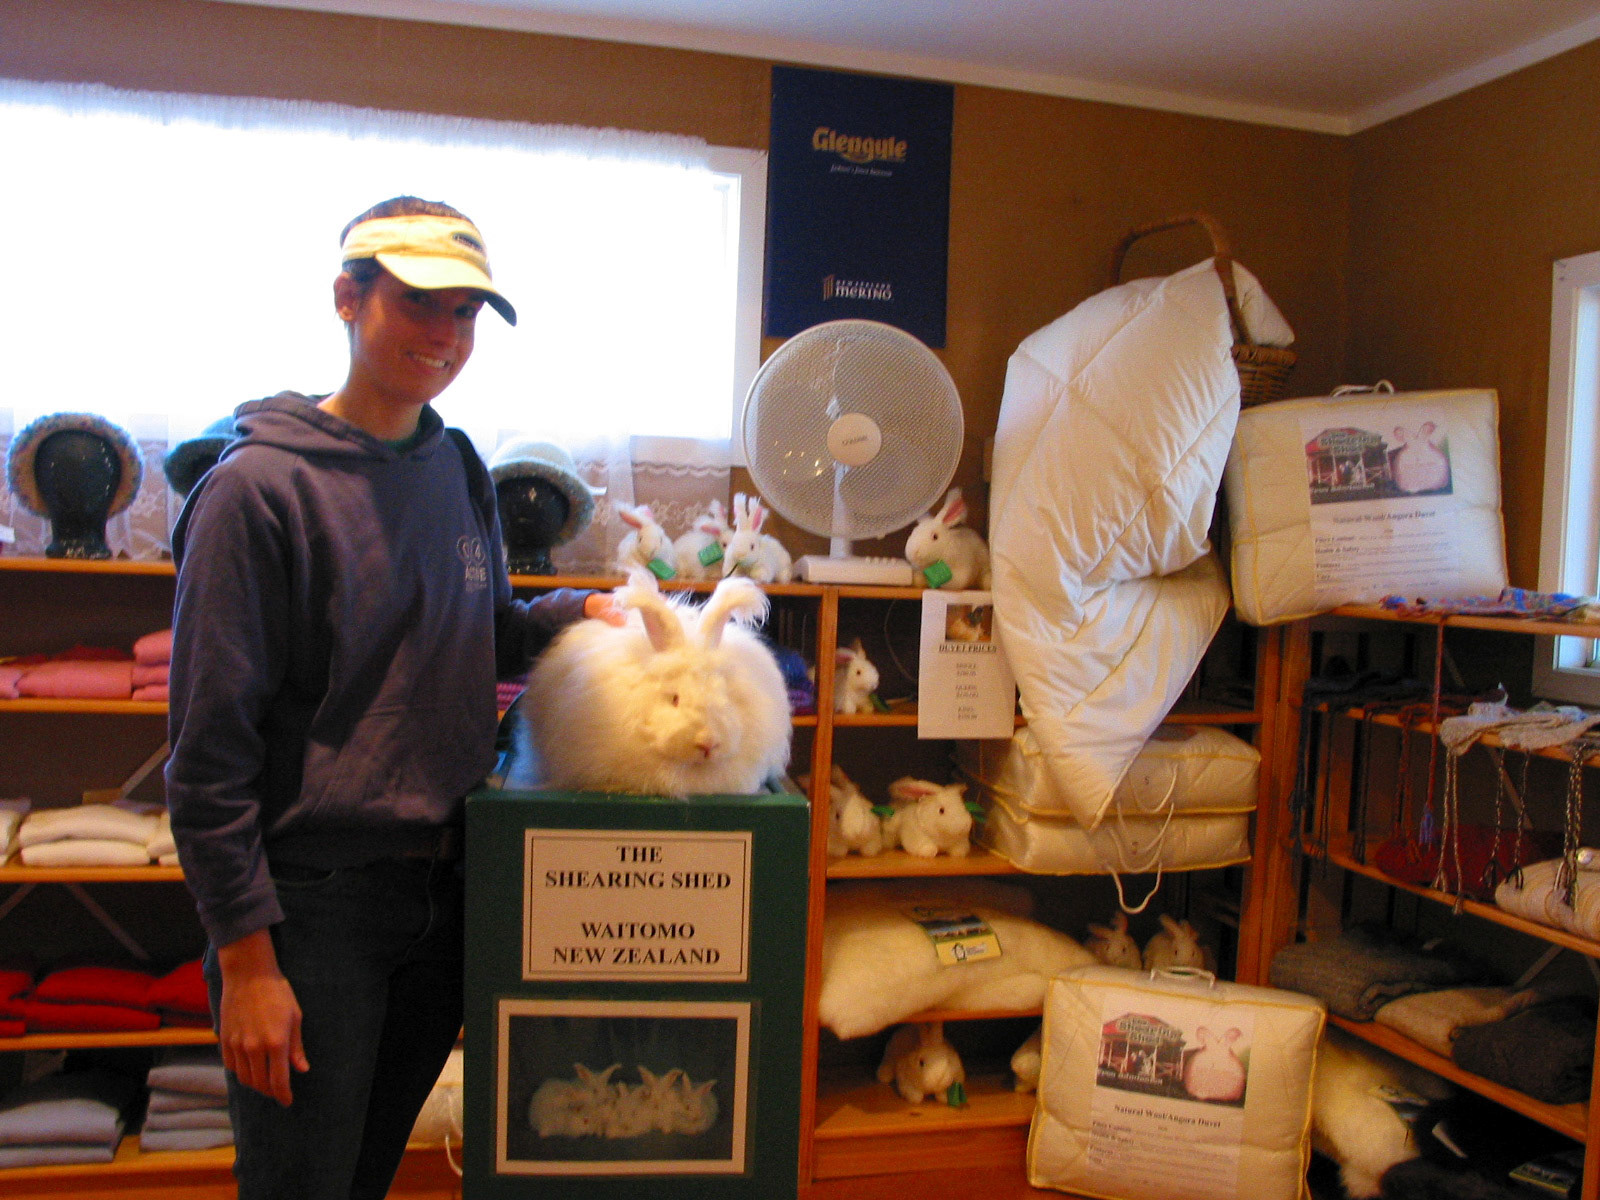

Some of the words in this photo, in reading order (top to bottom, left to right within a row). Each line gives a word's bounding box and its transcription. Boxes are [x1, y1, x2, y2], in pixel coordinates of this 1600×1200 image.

[812, 126, 908, 161] Glengyle
[616, 845, 663, 863] THE
[545, 870, 665, 889] SHEARING
[671, 871, 732, 890] SHED
[581, 921, 695, 940] WAITOMO
[552, 947, 606, 965] NEW
[612, 947, 720, 966] ZEALAND
[1114, 1104, 1143, 1117] Natural
